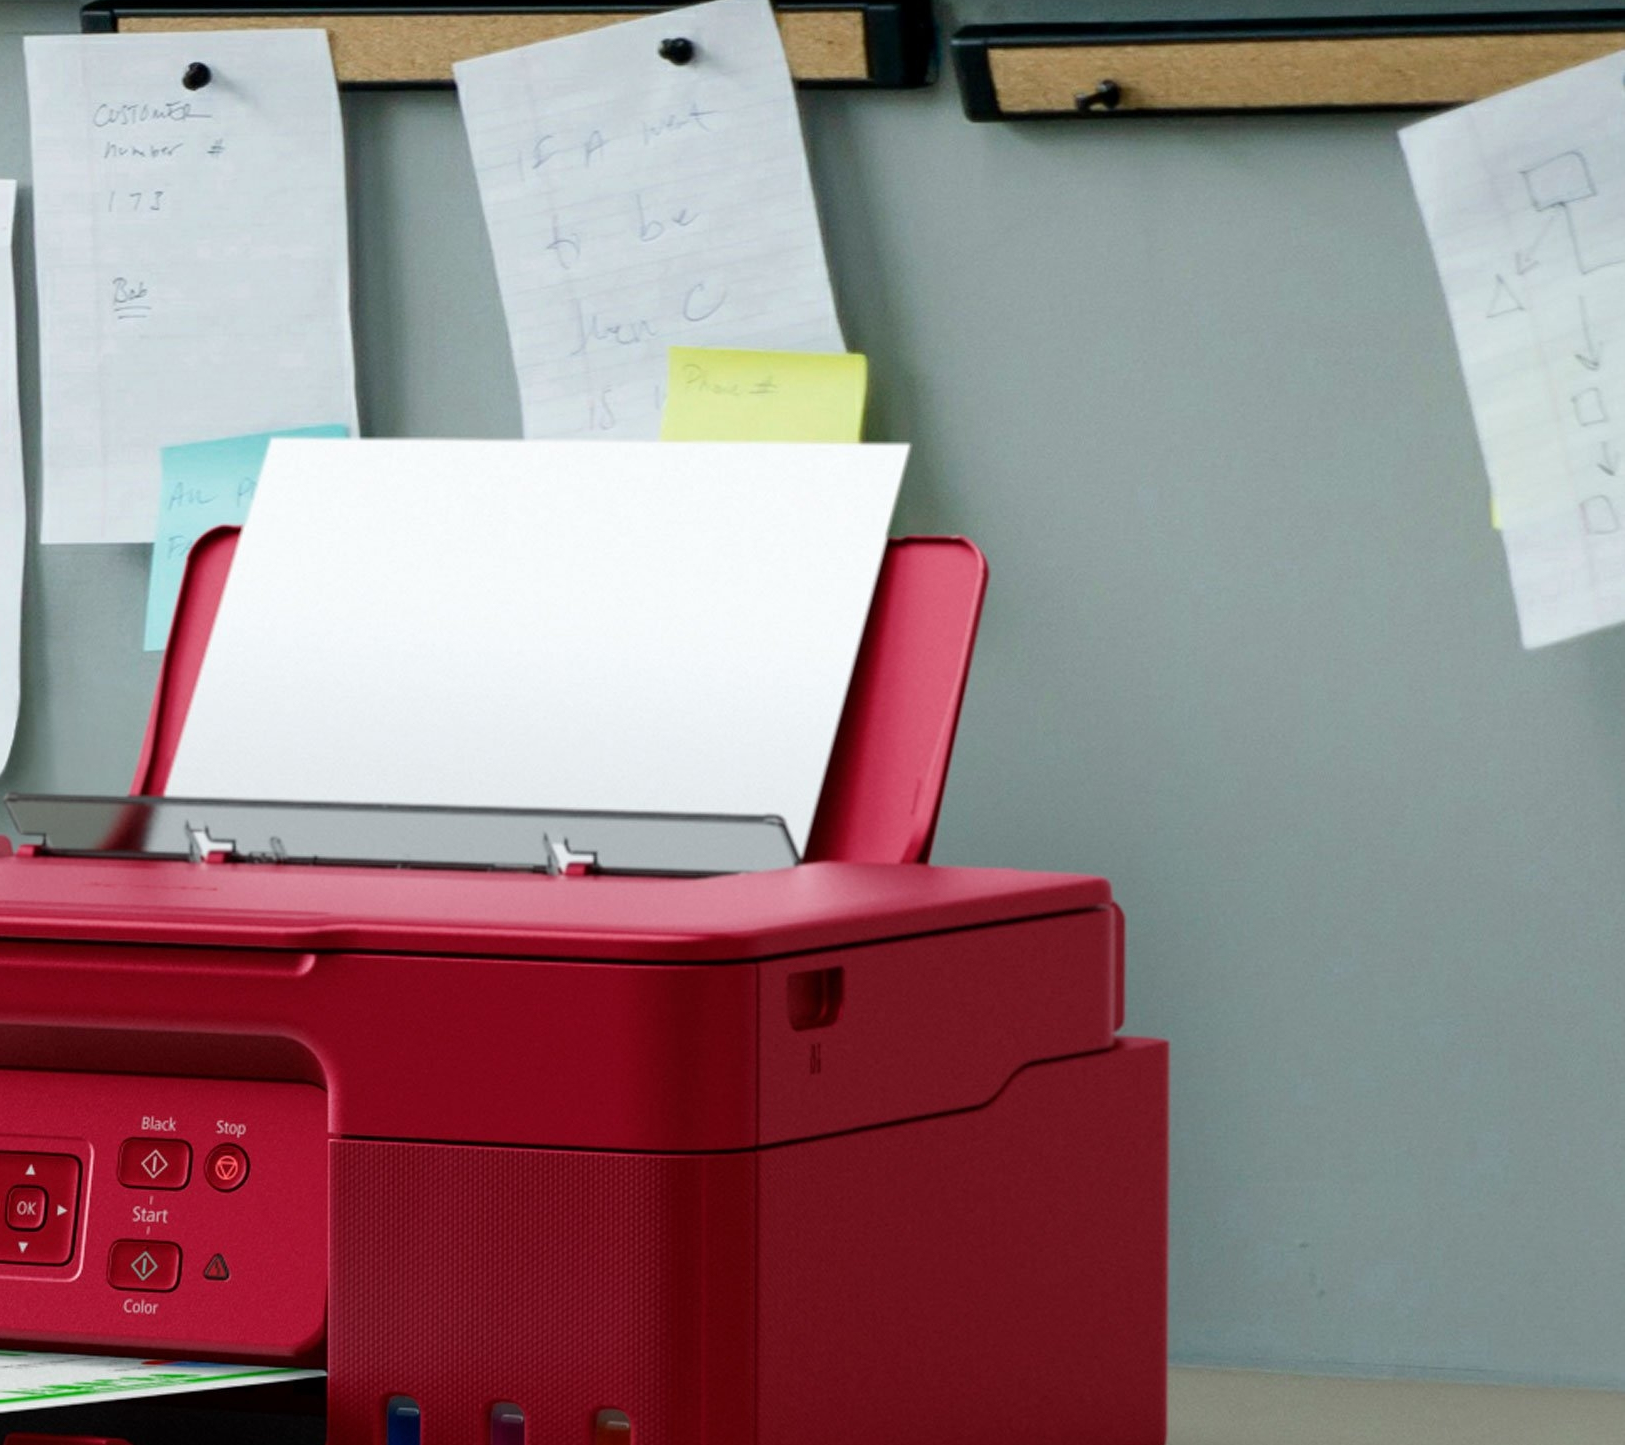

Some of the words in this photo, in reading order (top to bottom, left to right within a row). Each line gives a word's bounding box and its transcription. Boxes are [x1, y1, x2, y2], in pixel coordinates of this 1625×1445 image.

[635, 193, 701, 242] be
[141, 1116, 176, 1132] Black
[216, 1120, 246, 1138] Stop
[16, 1200, 37, 1216] OK
[132, 1206, 168, 1224] Start
[123, 1299, 159, 1315] Color
